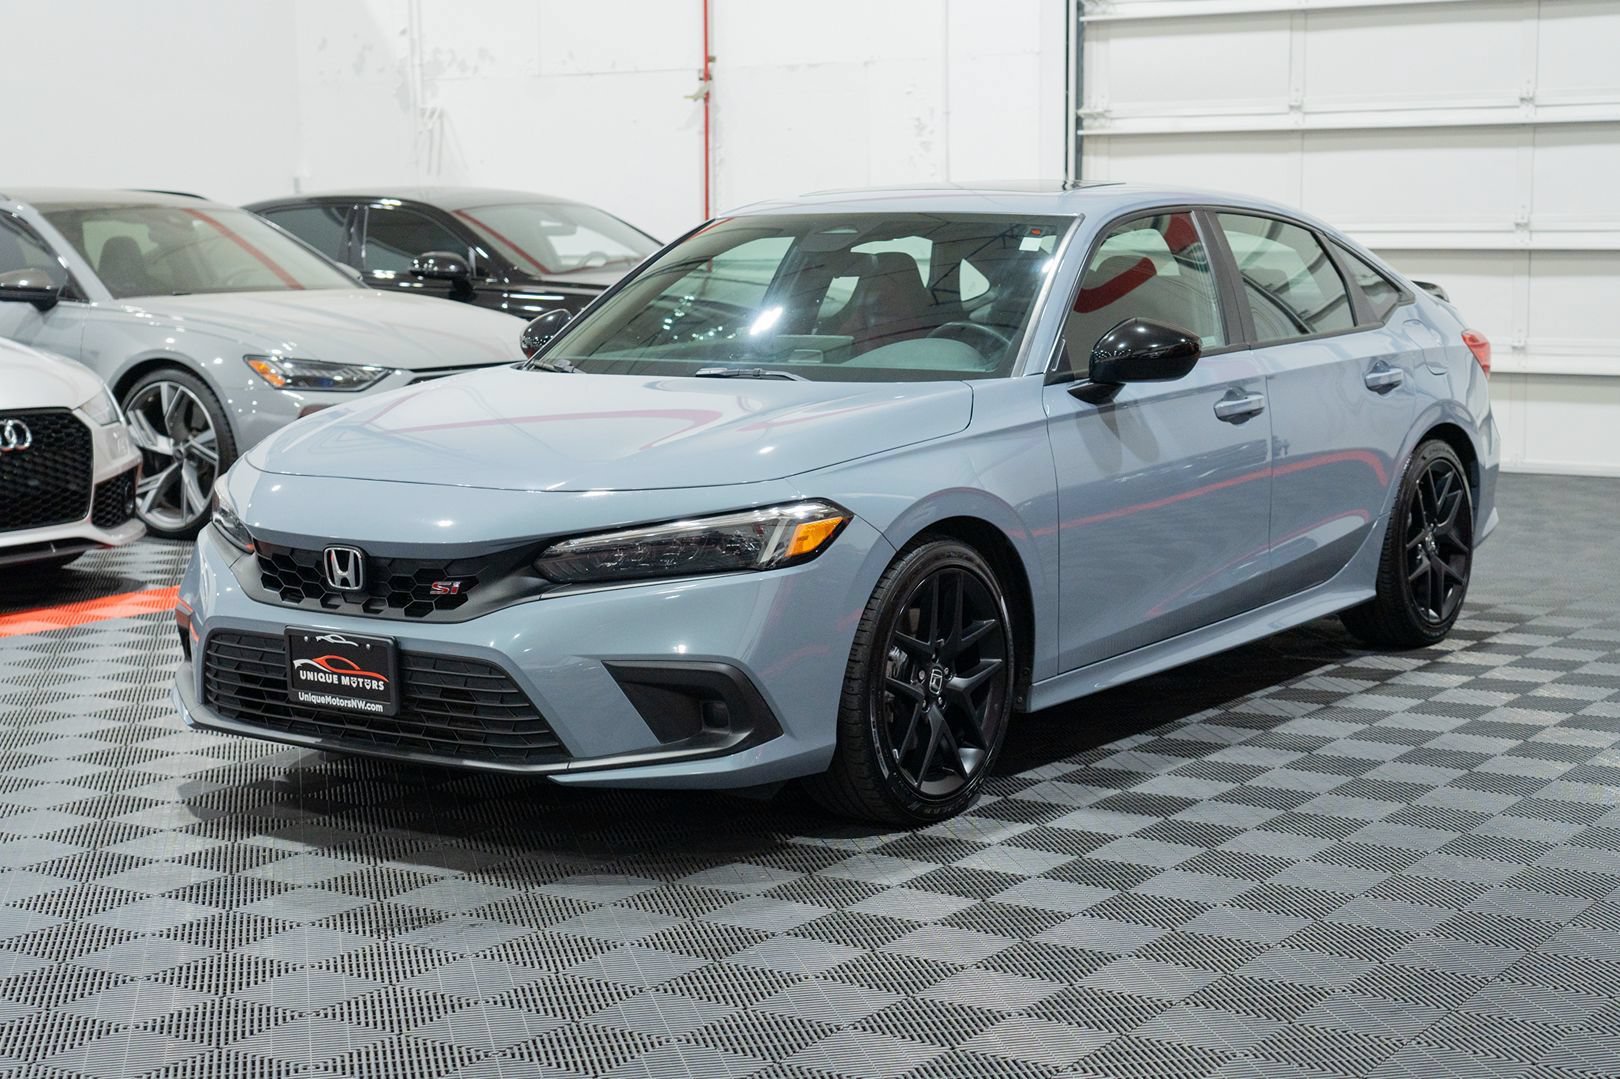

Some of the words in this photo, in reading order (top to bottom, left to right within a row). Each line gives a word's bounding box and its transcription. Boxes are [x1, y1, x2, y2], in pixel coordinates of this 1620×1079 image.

[299, 670, 339, 685] UNIQUE
[341, 676, 385, 691] MOTORS
[298, 691, 384, 713] UniqueMotorsNW.com
